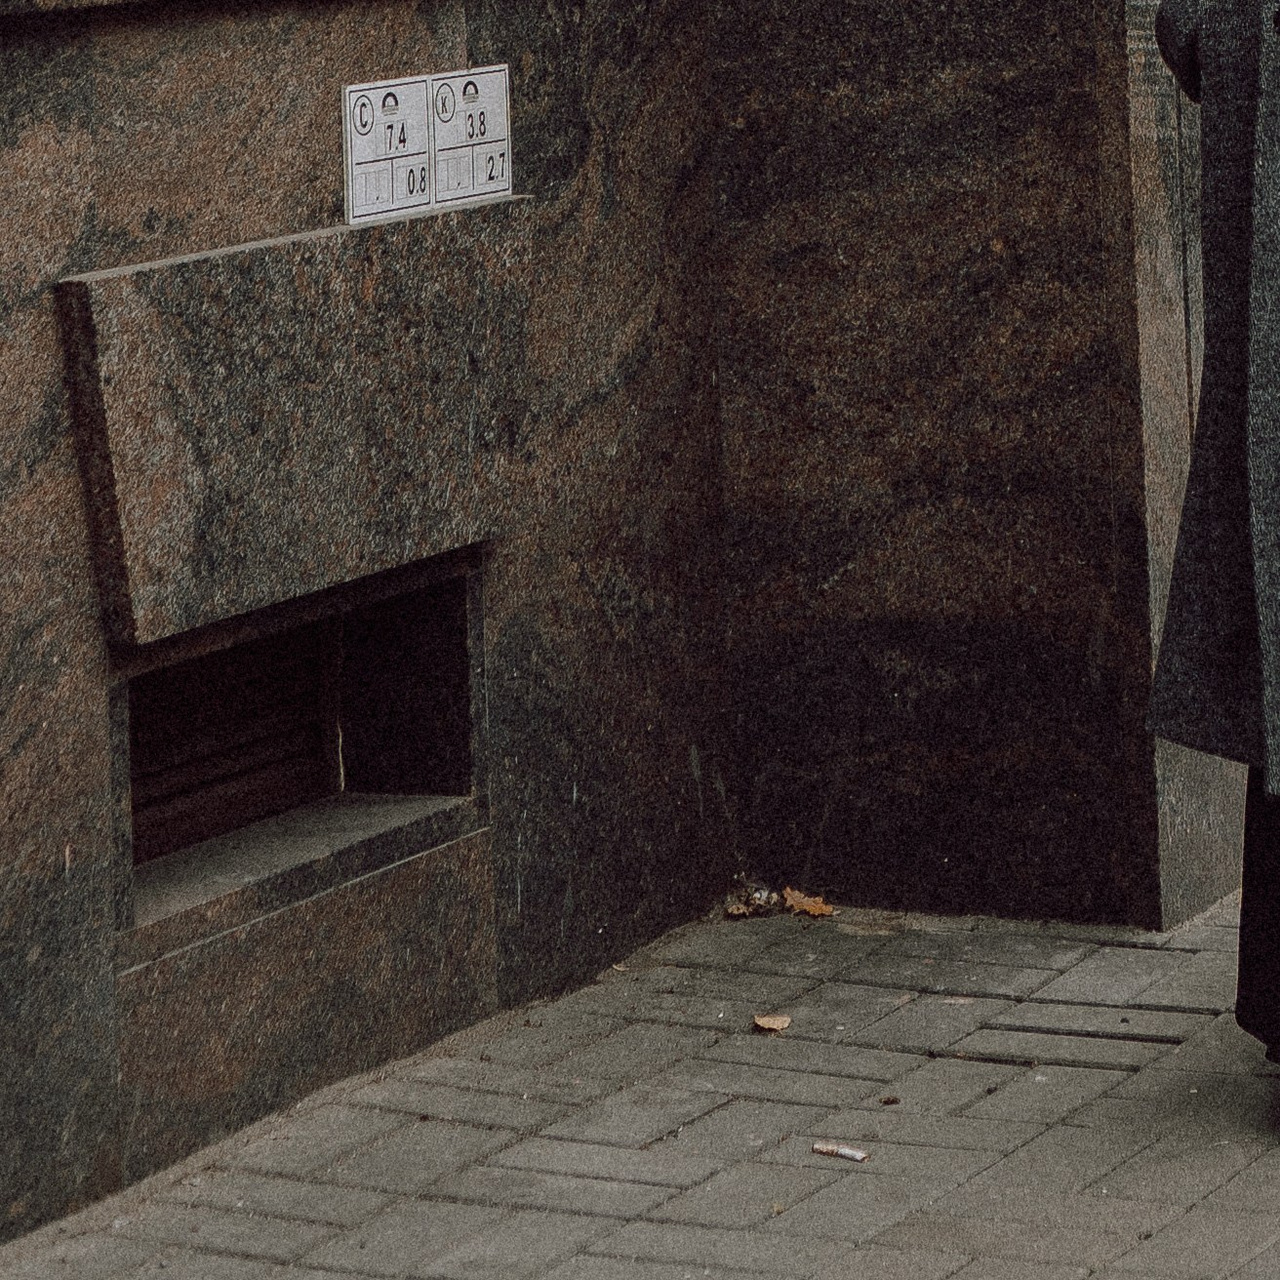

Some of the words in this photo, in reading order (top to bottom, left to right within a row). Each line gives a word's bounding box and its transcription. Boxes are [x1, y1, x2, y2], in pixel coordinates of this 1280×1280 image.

[386, 122, 407, 151] 7.4
[467, 110, 487, 139] 3.8
[407, 166, 426, 195] 0.8
[487, 151, 506, 181] 2.7
